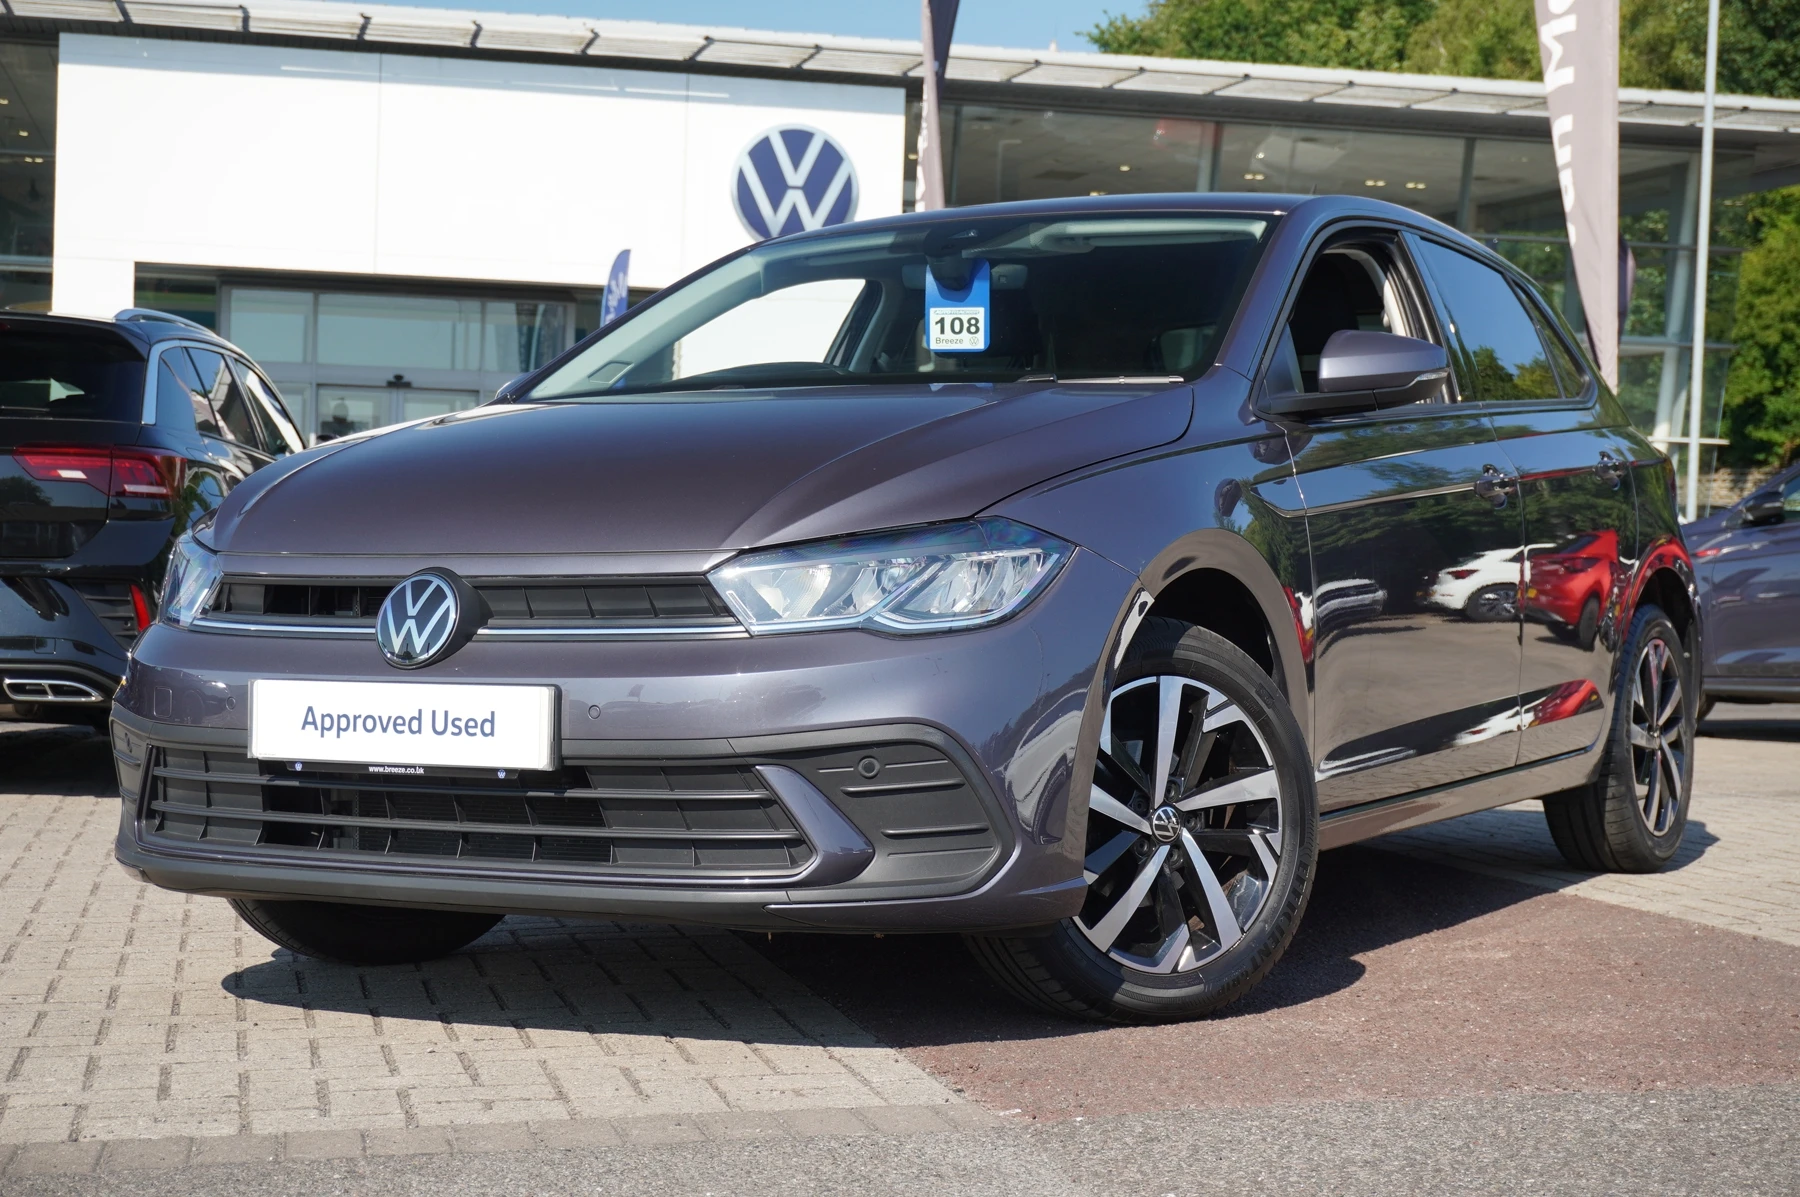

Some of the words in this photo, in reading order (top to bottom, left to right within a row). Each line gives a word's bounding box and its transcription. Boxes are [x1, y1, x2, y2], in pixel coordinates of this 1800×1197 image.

[935, 317, 980, 335] 108
[935, 337, 964, 345] Breeze
[301, 705, 423, 739] Approved
[431, 709, 496, 738] Used
[368, 765, 425, 774] www.breeze.co.uk
